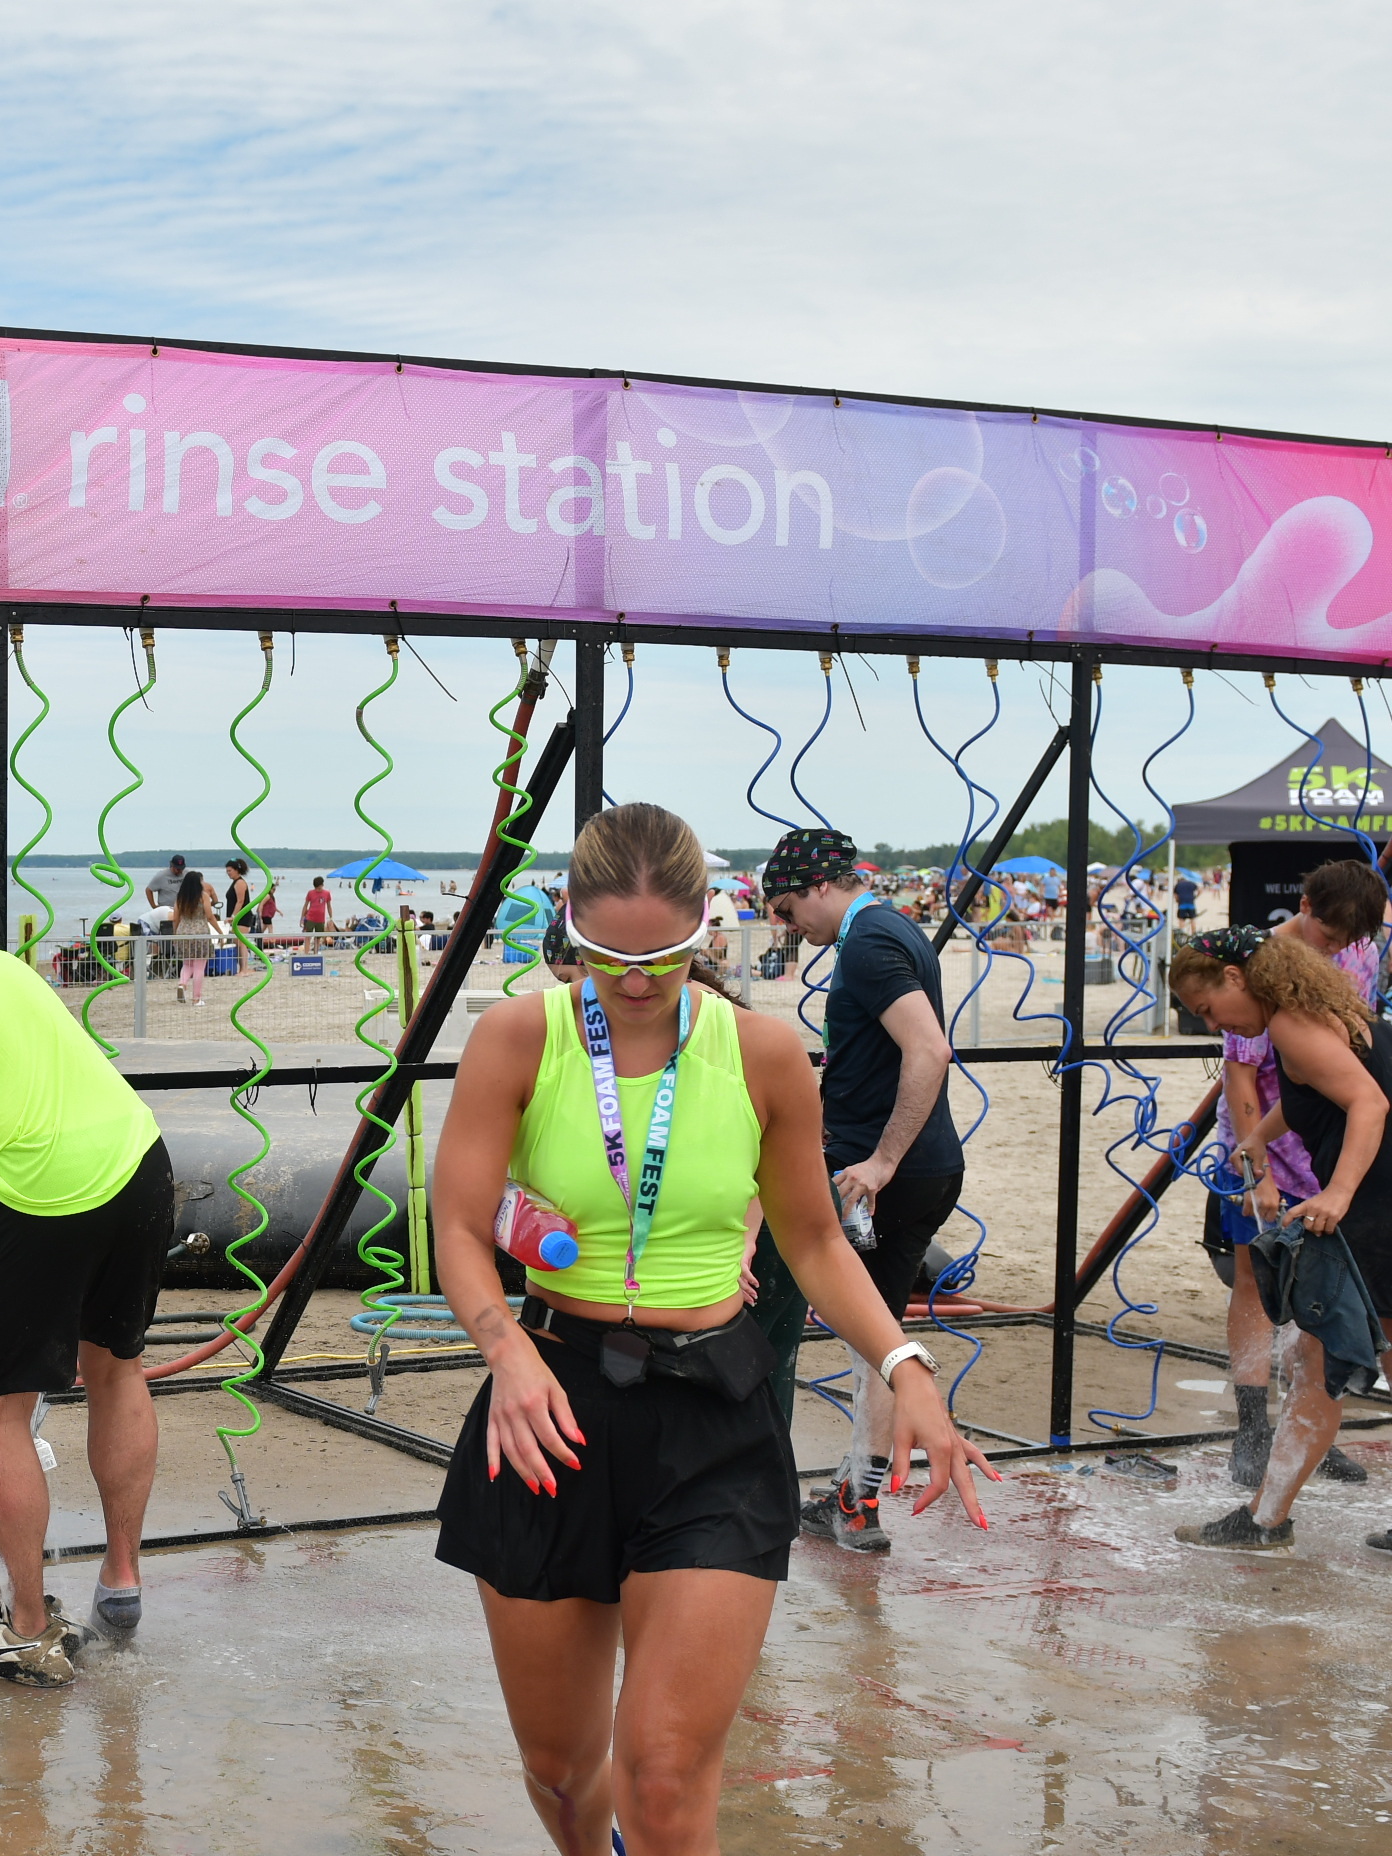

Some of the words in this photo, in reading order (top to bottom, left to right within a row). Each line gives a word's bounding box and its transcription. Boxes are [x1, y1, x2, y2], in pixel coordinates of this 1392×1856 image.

[68, 392, 388, 525] rinse
[432, 426, 834, 550] station
[1287, 765, 1387, 790] 5K
[1289, 788, 1384, 803] FOAM
[1265, 883, 1281, 894] WE
